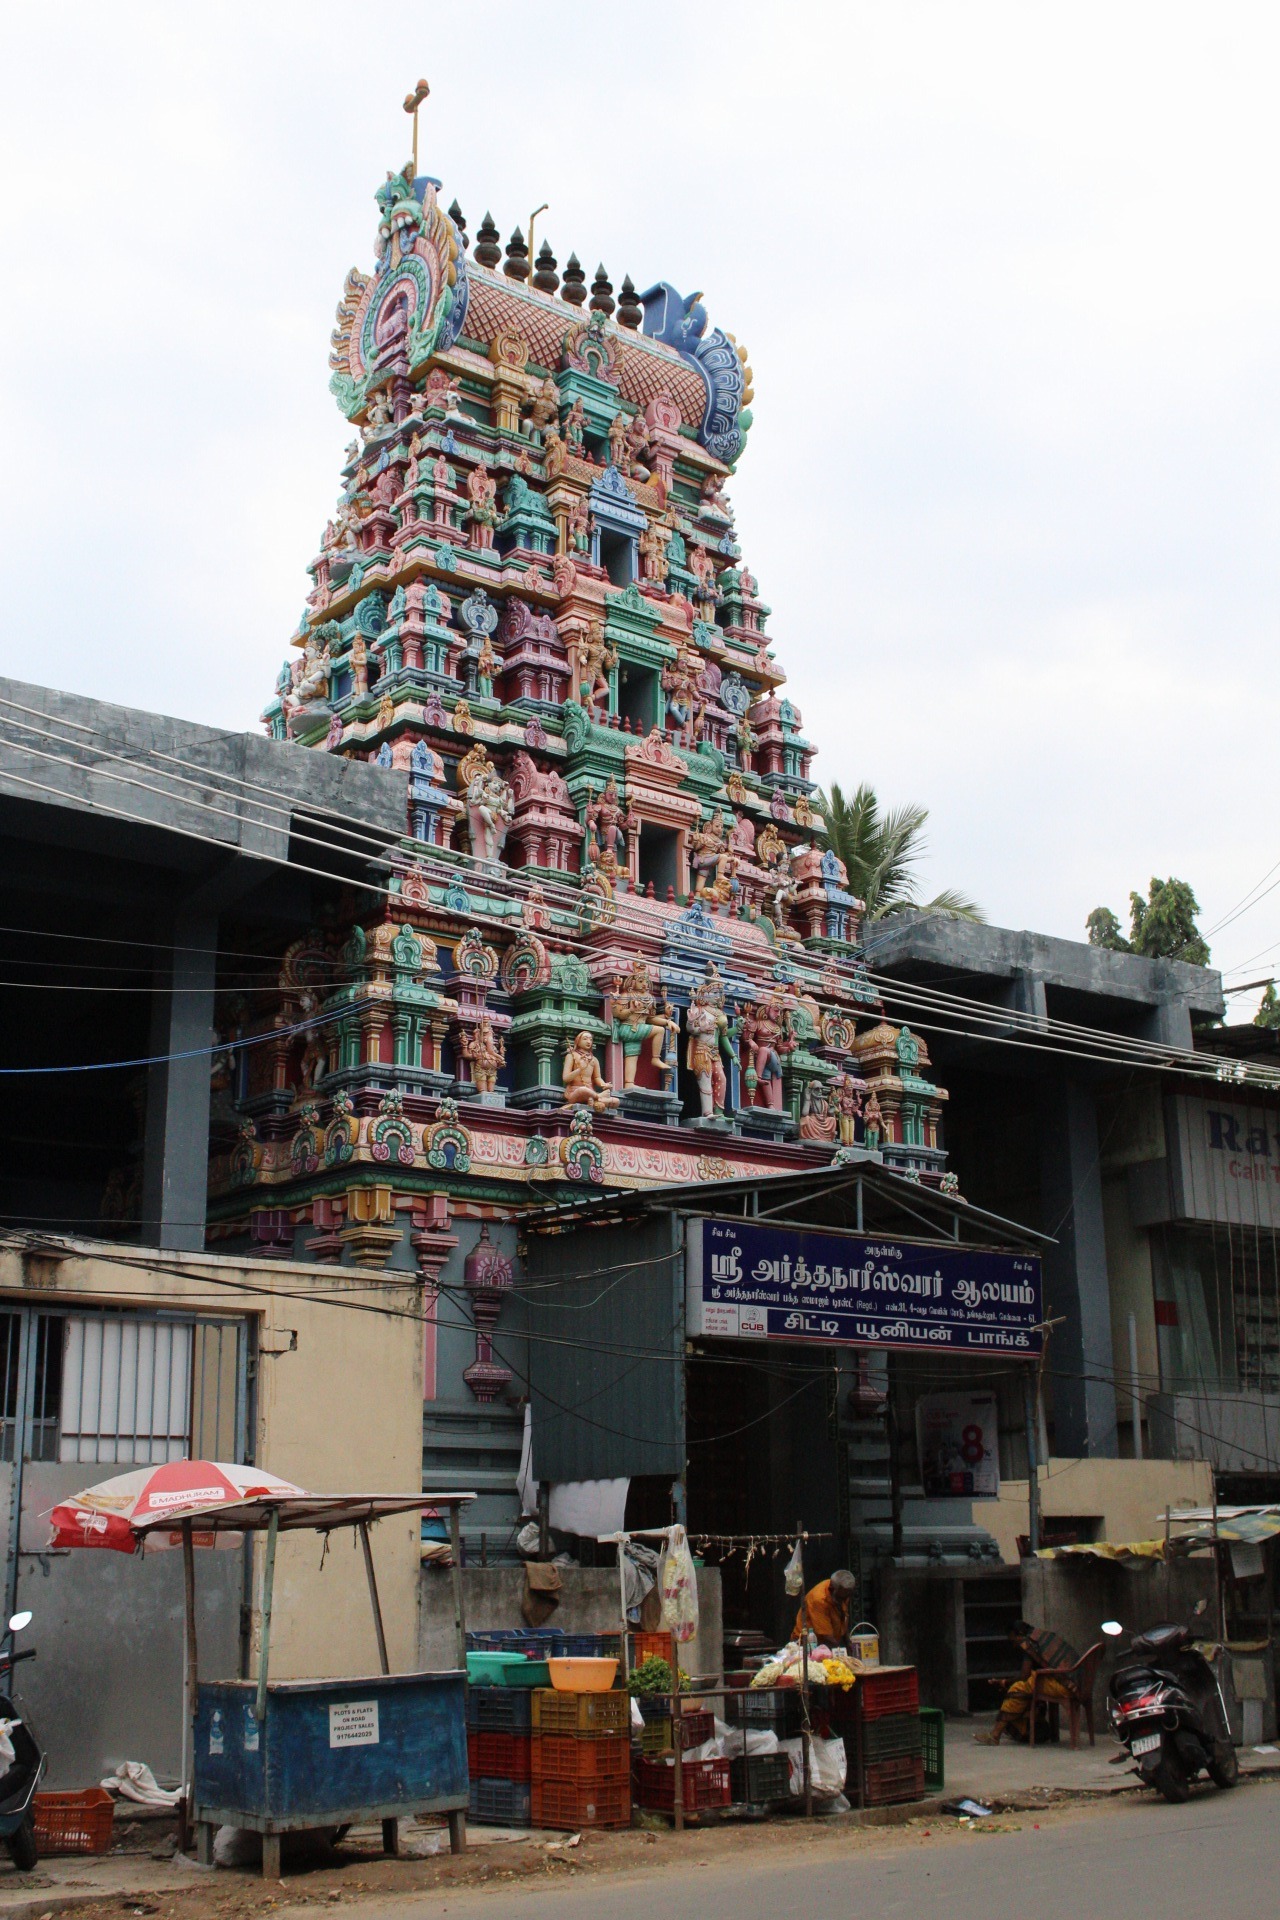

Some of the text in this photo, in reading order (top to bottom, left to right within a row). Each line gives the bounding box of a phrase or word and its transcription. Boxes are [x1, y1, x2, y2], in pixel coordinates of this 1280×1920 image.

[1229, 1160, 1265, 1181] Call
[711, 1227, 736, 1239] சிவ சிவ
[751, 1254, 943, 1298] அர்த்தநாரீஸ்வரர்
[951, 1279, 1035, 1308] ஆலயம்
[724, 1286, 780, 1302] அர்த்தநாரீஸ்வரர்
[741, 1322, 764, 1331] CUB
[784, 1312, 1030, 1347] சிட்டி யூனியன் பாங்க்
[158, 1490, 219, 1504] MADHURAM
